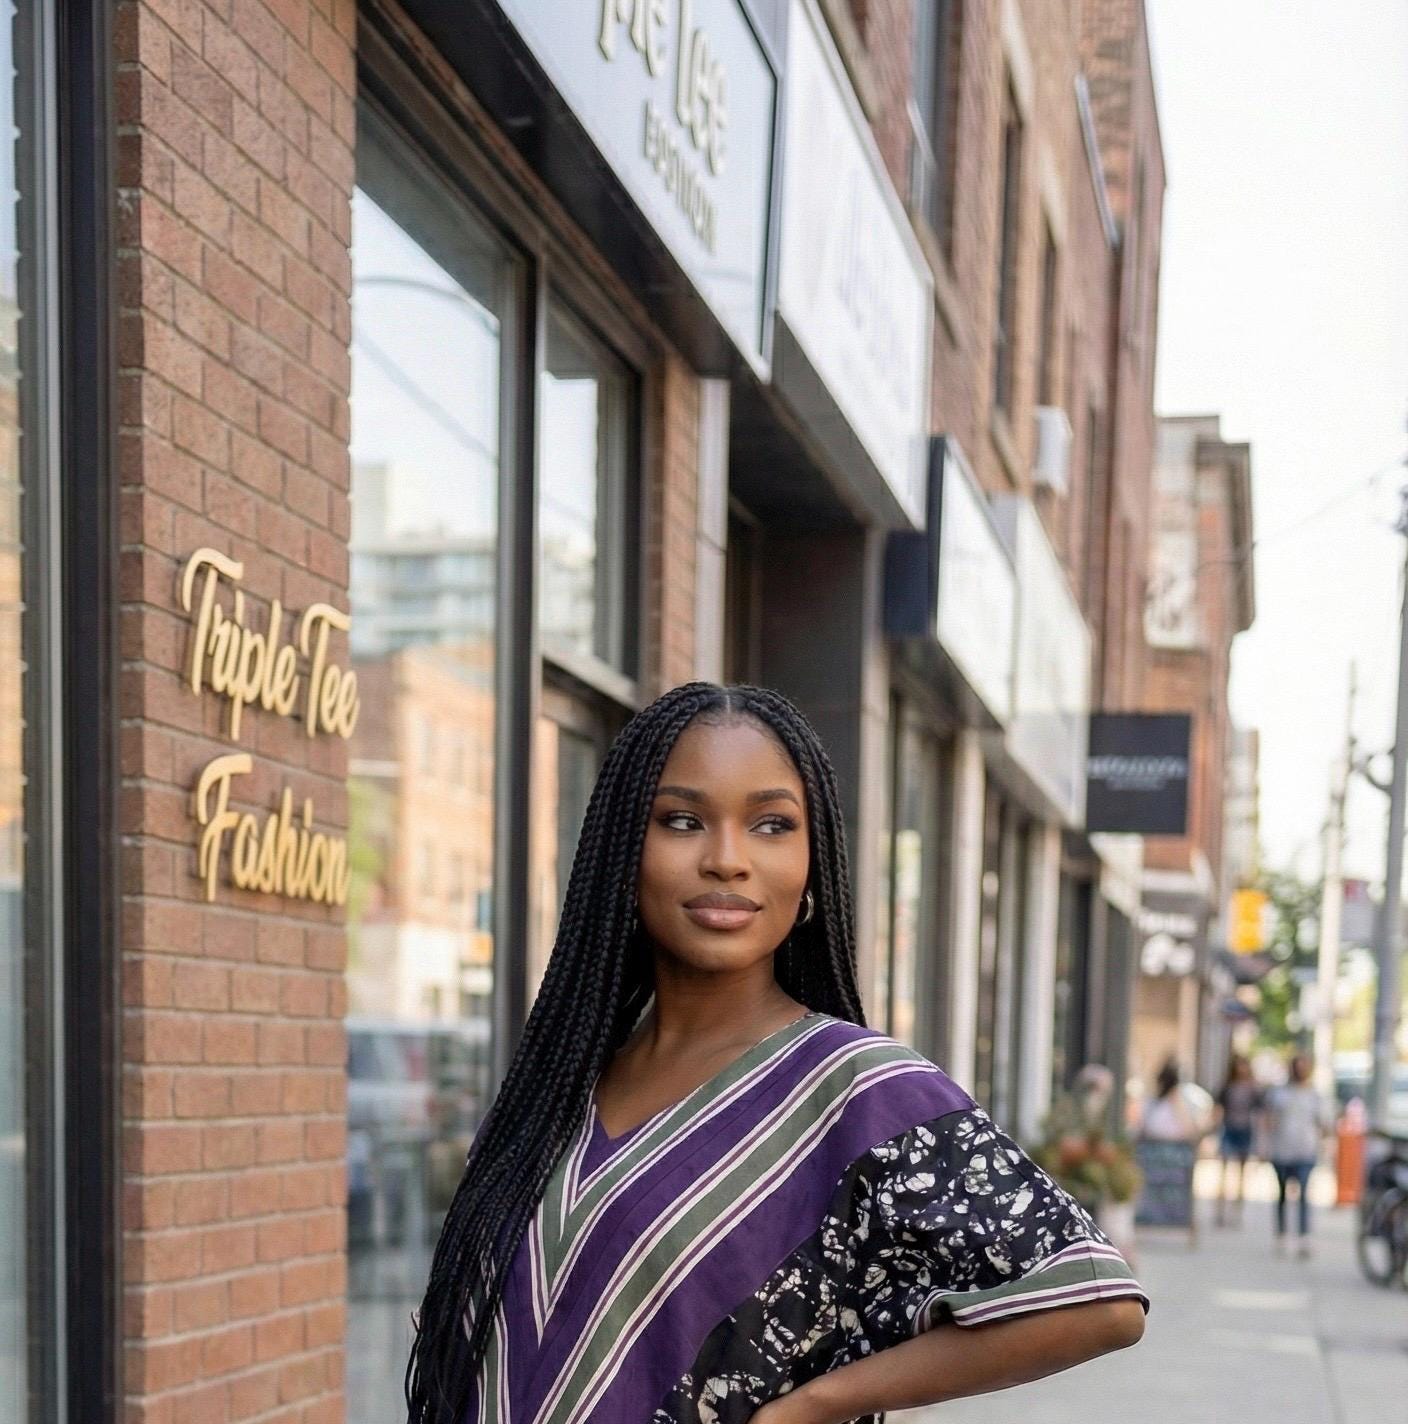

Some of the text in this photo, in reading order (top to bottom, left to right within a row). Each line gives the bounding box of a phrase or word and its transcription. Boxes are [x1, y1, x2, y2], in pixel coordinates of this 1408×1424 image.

[182, 548, 360, 741] Triple Tee
[197, 753, 348, 906] Fashion
